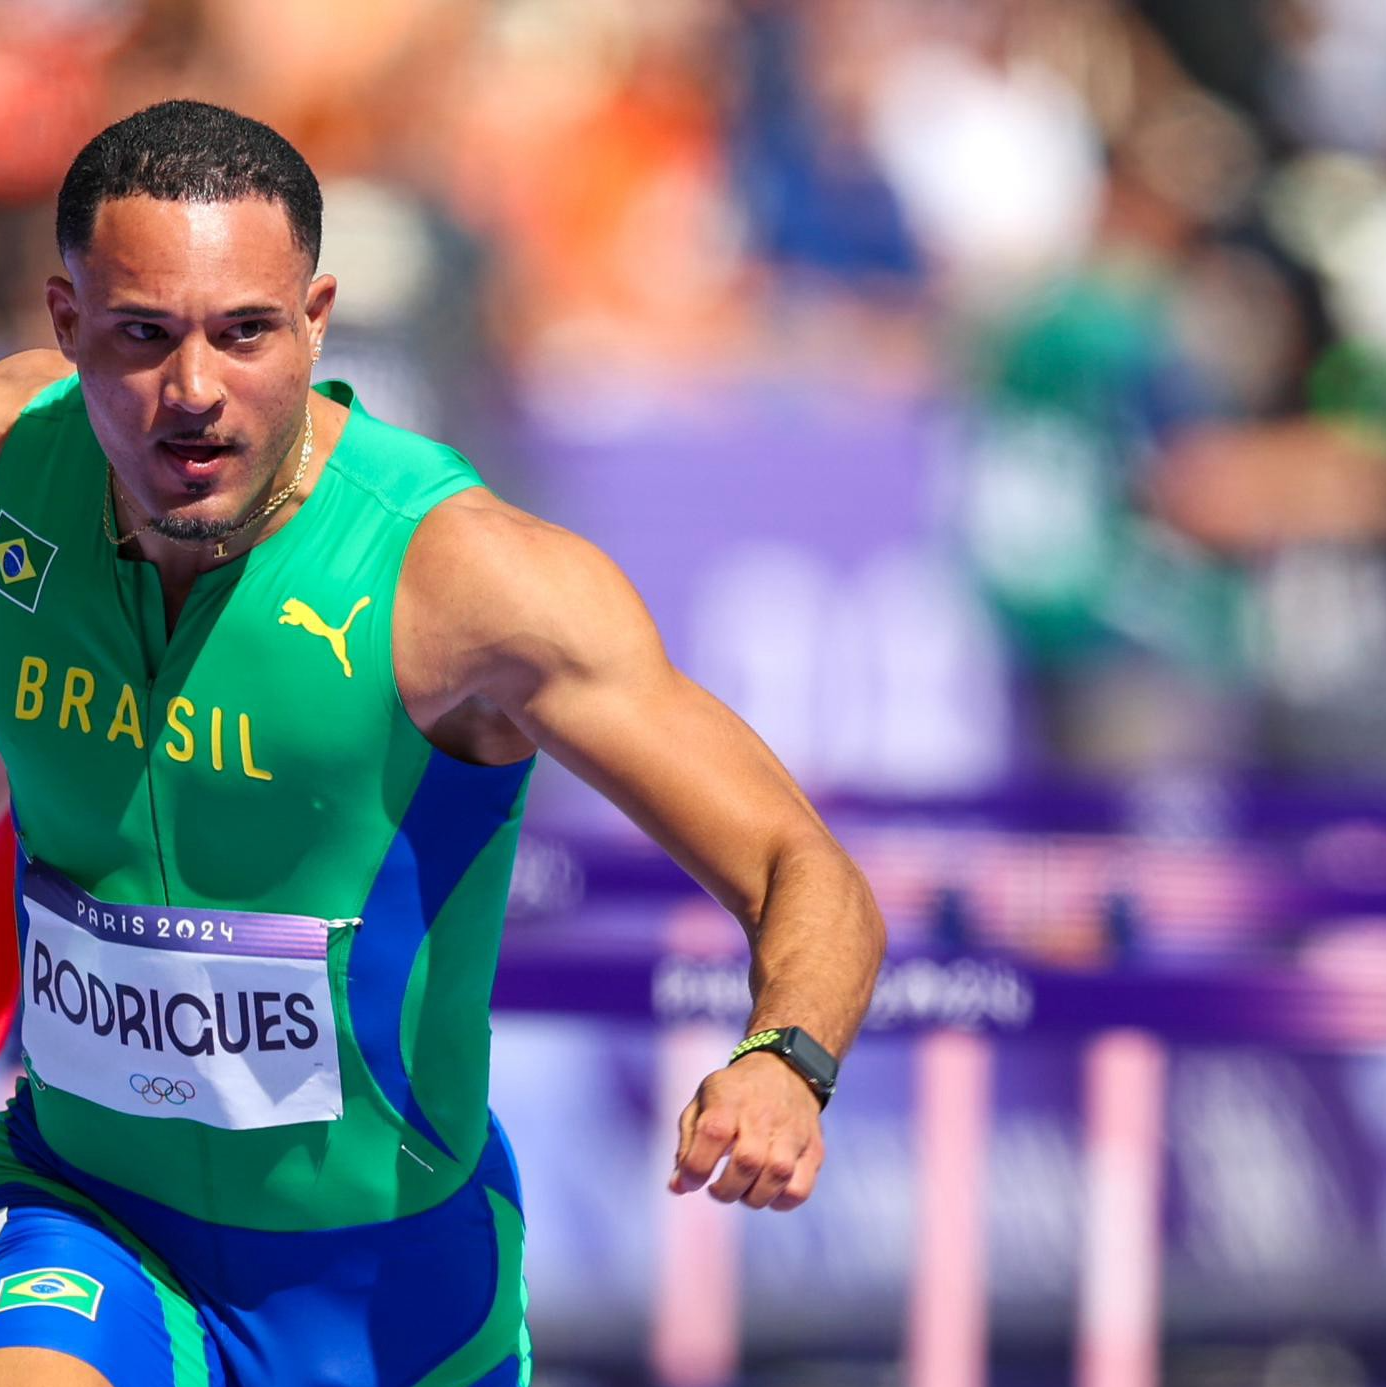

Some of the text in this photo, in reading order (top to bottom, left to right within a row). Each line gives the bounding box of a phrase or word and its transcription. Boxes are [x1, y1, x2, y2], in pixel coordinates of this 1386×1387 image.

[15, 656, 273, 782] BRASIL
[77, 900, 234, 942] PARIS 2024
[32, 939, 319, 1058] RODRIGUES
